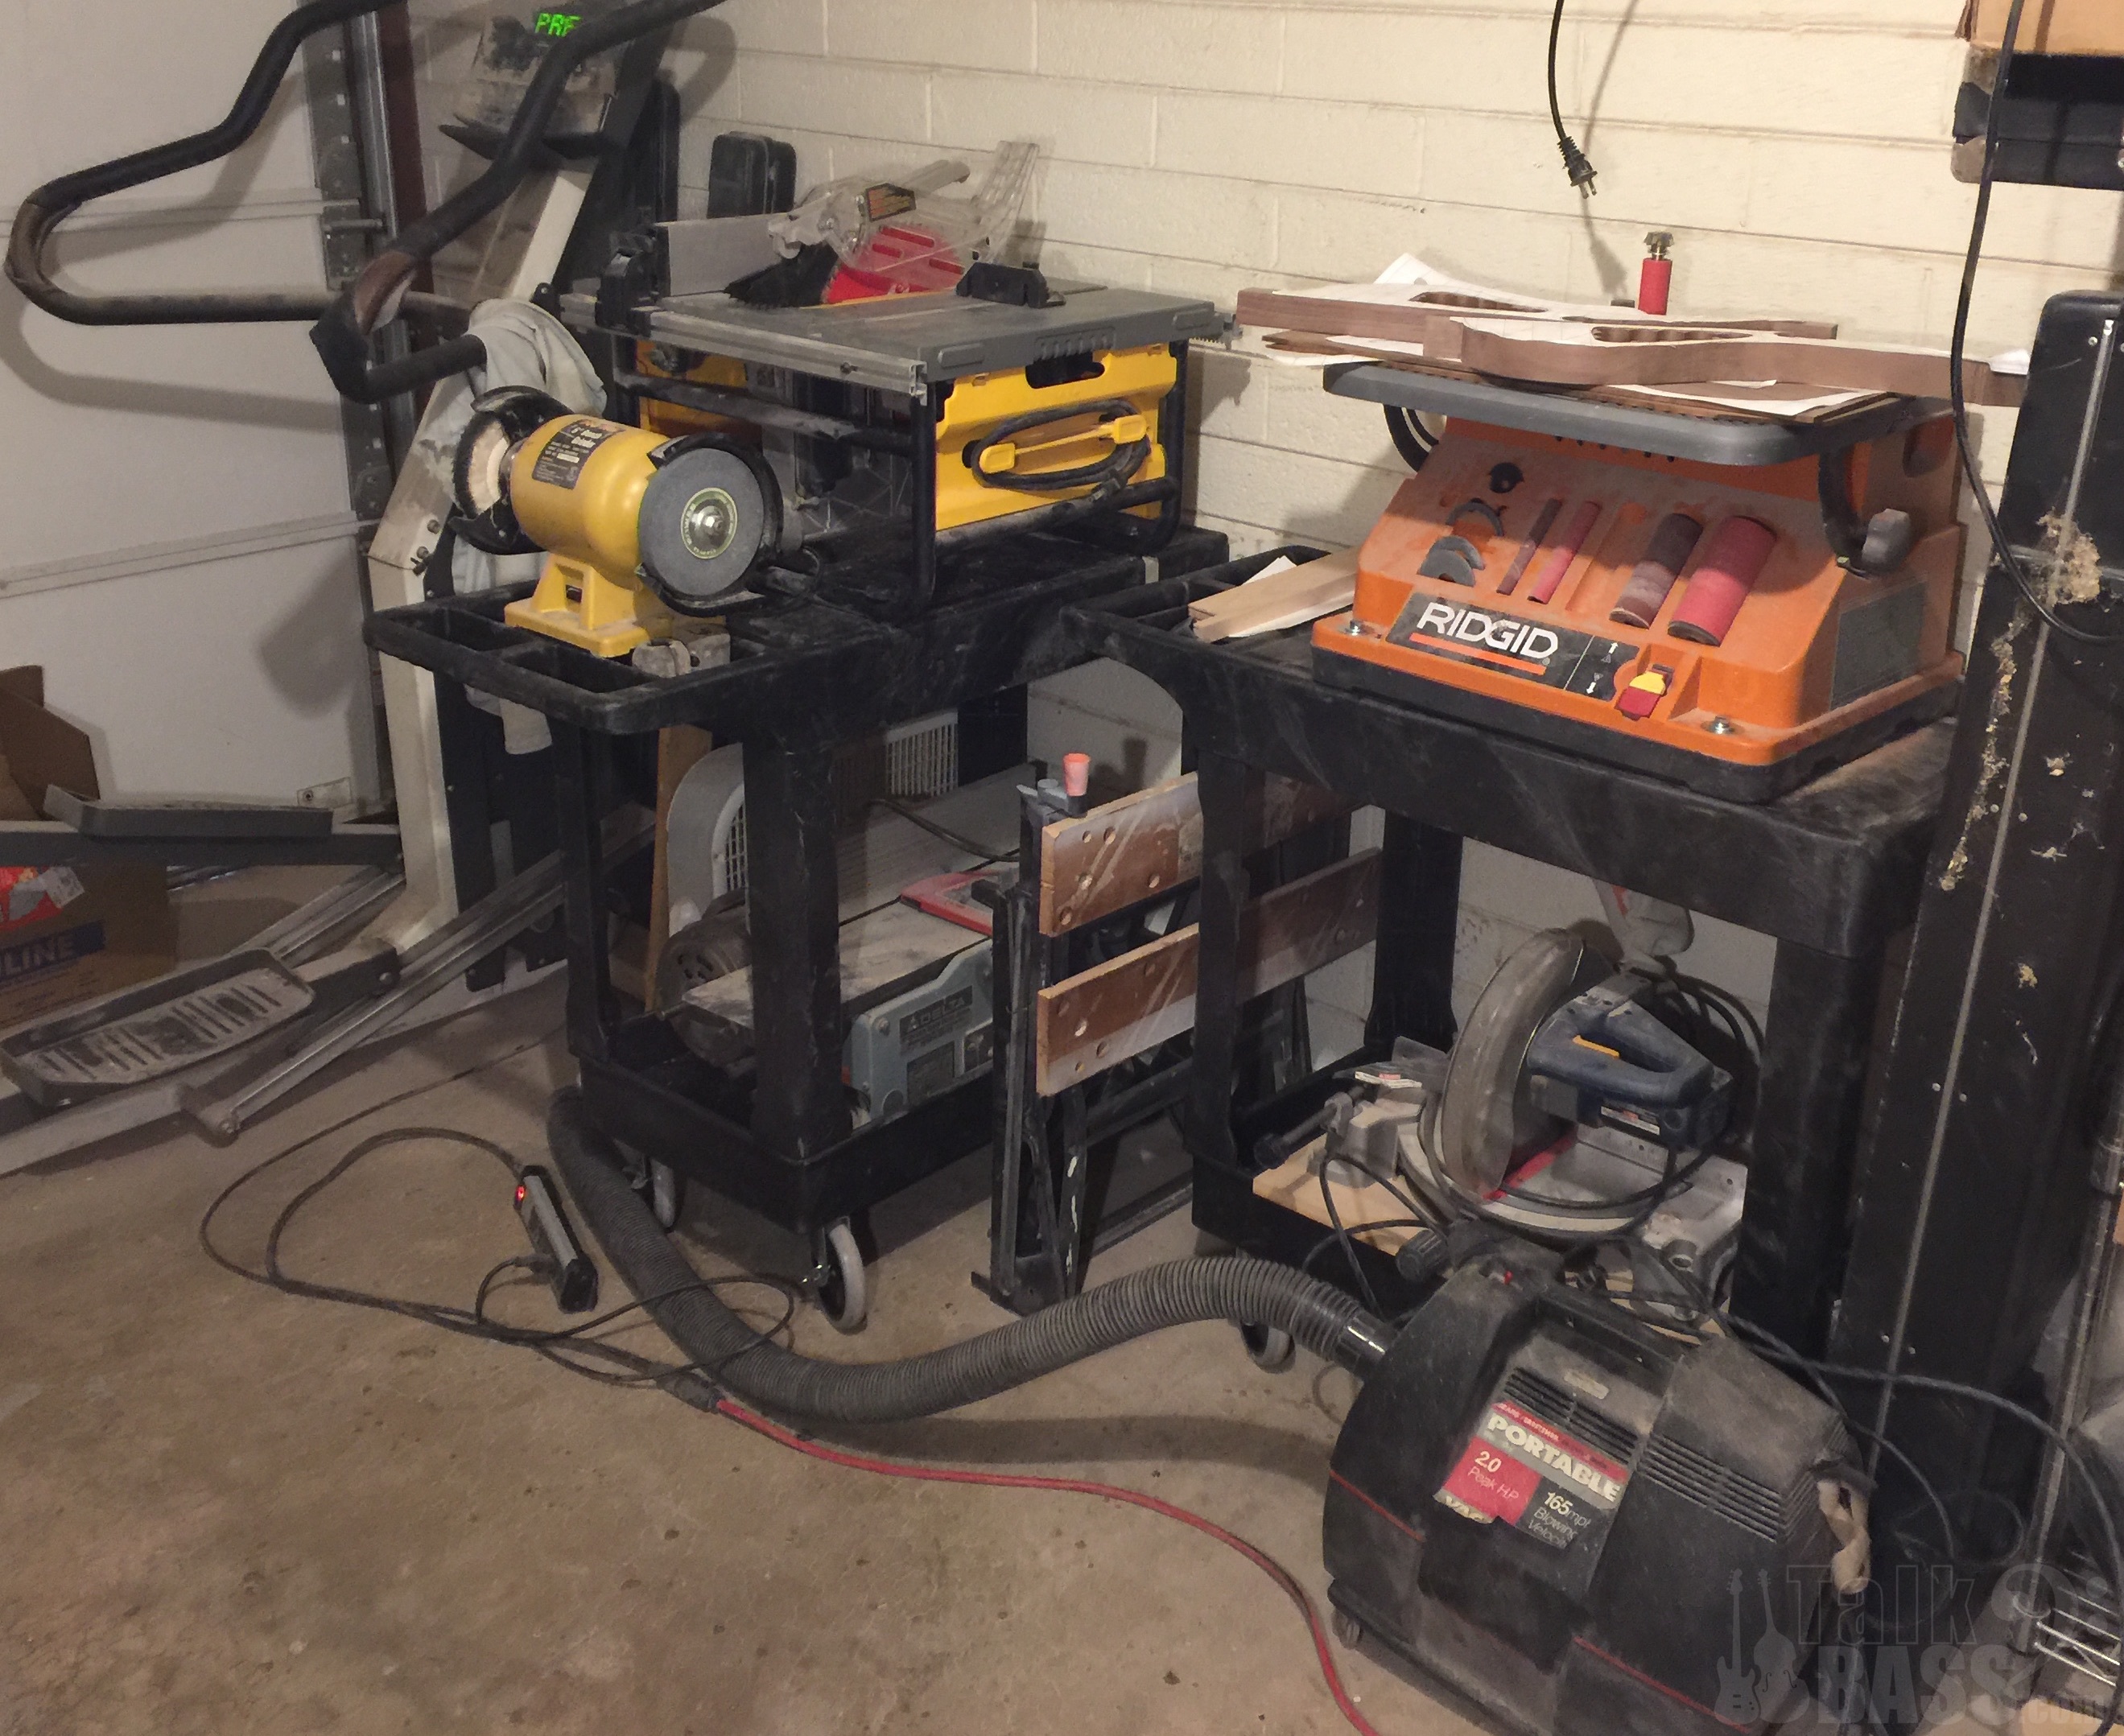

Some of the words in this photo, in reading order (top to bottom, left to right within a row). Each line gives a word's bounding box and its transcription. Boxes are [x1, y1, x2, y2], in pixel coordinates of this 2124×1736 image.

[1416, 601, 1559, 660] RIDGID
[0, 934, 76, 975] LINE
[1467, 1466, 1496, 1490] Peak
[1487, 1414, 1621, 1503] PORTABLE
